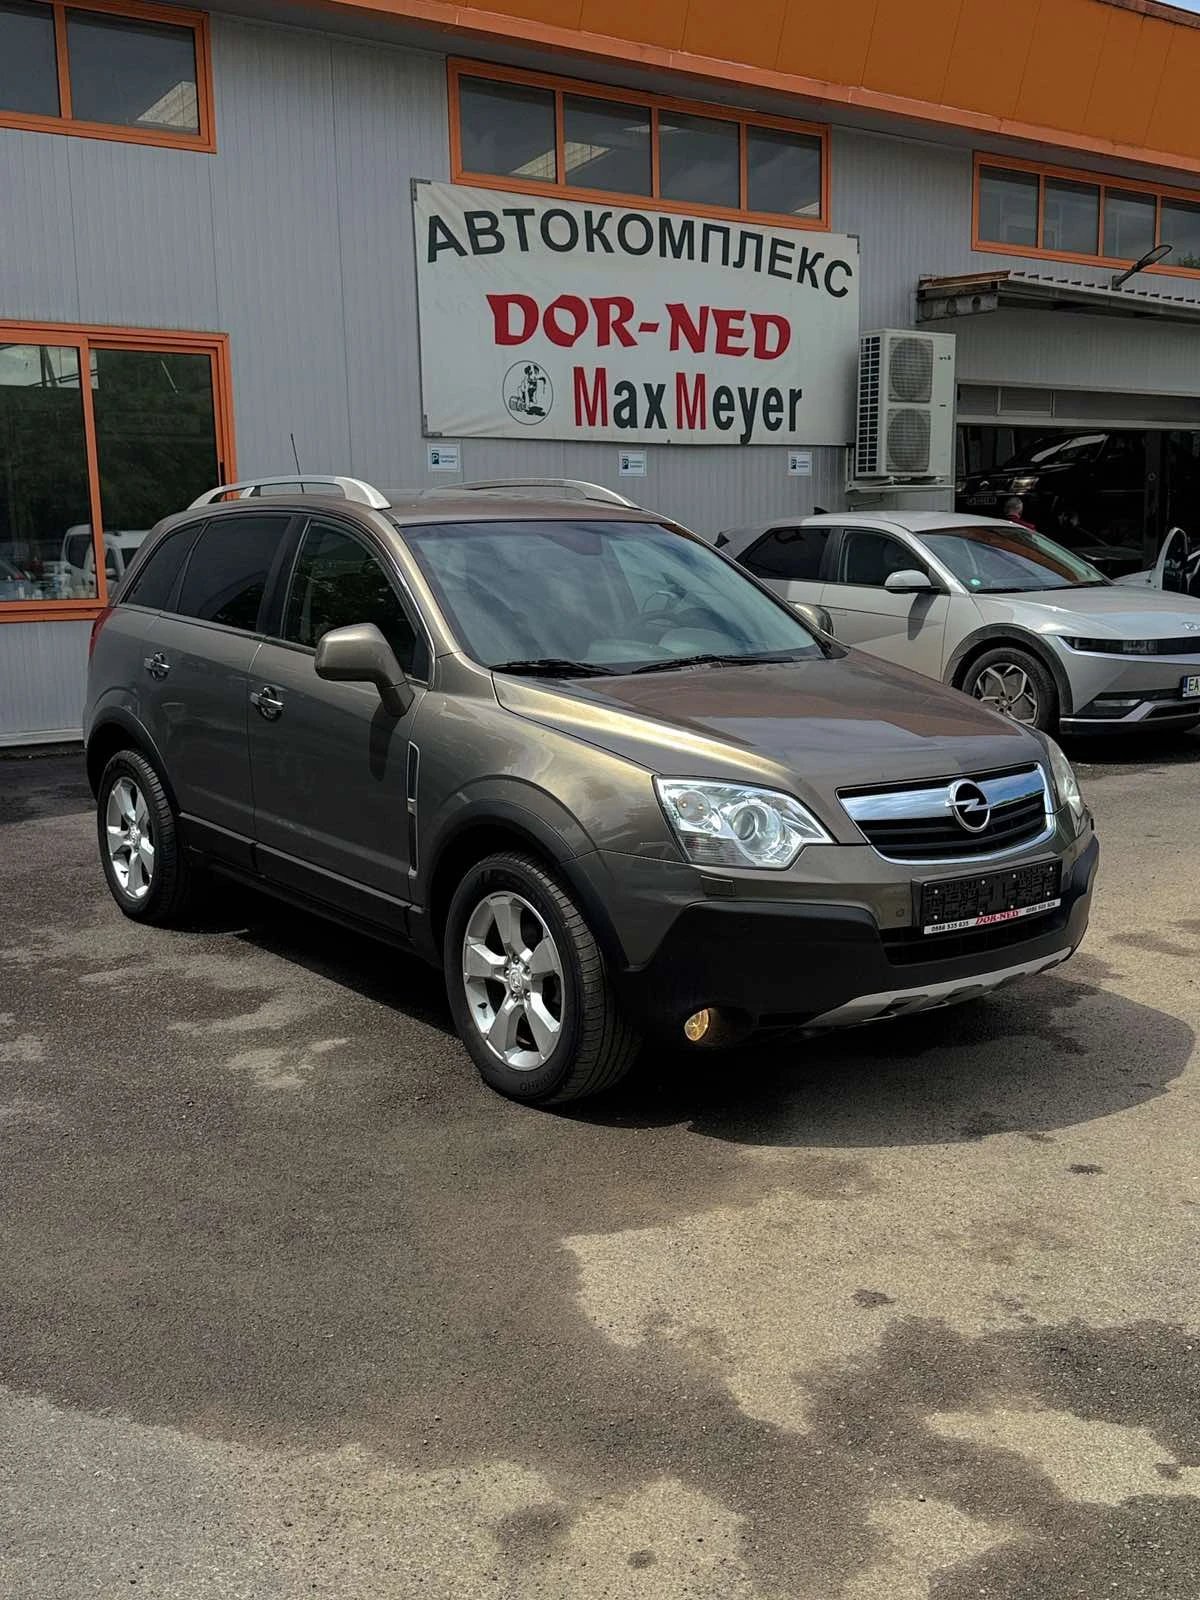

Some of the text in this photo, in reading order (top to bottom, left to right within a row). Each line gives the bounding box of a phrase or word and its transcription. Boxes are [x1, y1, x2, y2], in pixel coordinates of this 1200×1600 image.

[427, 208, 853, 298] АВТОКОМПЛЕКС
[486, 294, 791, 360] DOR-NED
[573, 366, 802, 444] MaxMeyer
